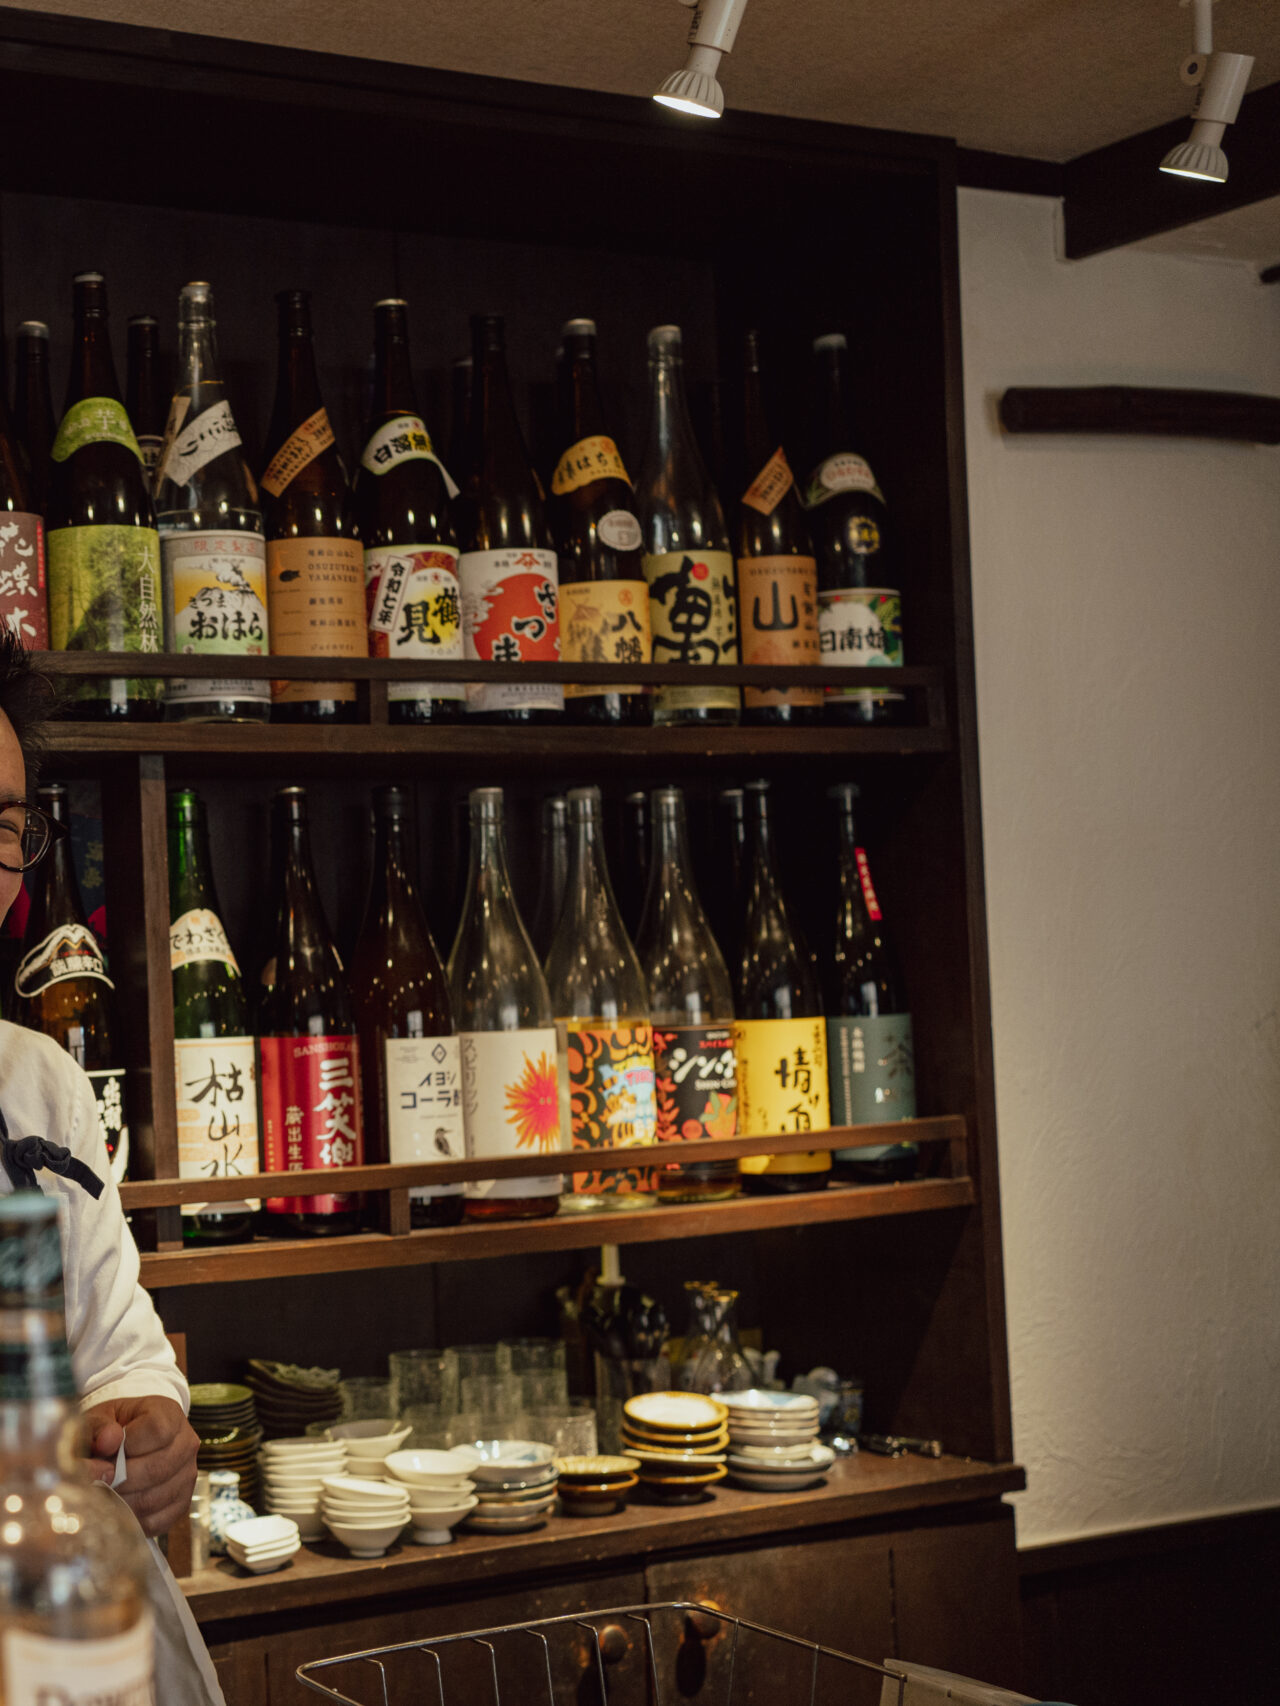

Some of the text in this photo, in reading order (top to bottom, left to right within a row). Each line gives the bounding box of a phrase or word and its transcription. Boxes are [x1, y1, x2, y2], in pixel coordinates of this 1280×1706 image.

[376, 561, 406, 626] 令和七年
[396, 586, 461, 647] 鶴見
[753, 581, 799, 631] 山
[189, 610, 264, 641] おはら
[184, 1057, 245, 1178] 枯山水
